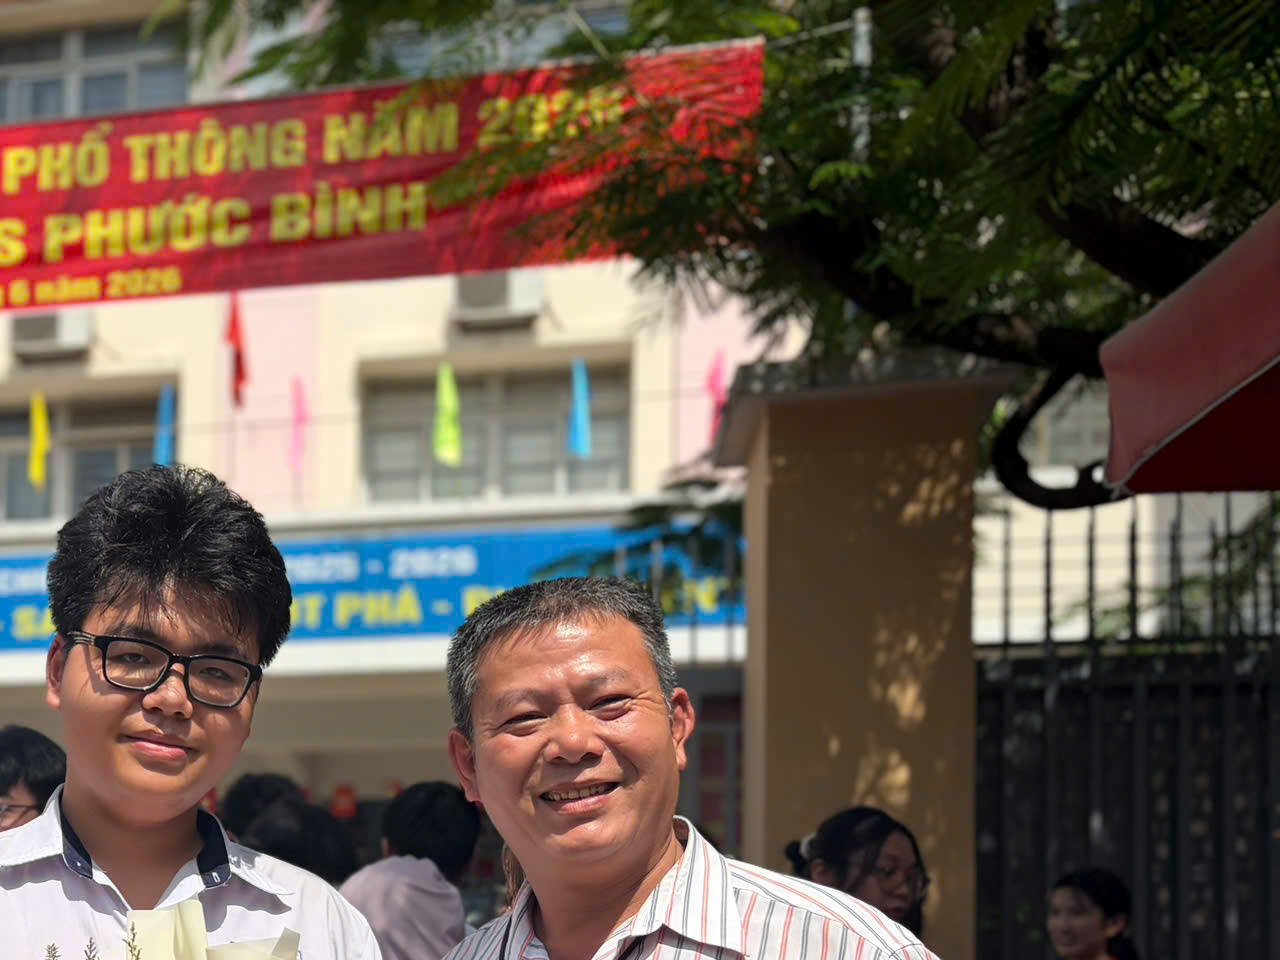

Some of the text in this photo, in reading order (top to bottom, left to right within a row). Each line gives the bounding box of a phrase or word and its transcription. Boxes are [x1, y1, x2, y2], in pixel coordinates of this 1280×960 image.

[1, 120, 113, 195] PHỔ
[124, 117, 308, 184] THÔNG
[323, 100, 460, 164] NĂM
[42, 194, 252, 263] PHƯỚC
[268, 180, 429, 243] BÌNH
[9, 278, 30, 305] 6
[33, 274, 101, 304] năm
[106, 265, 182, 298] 2026
